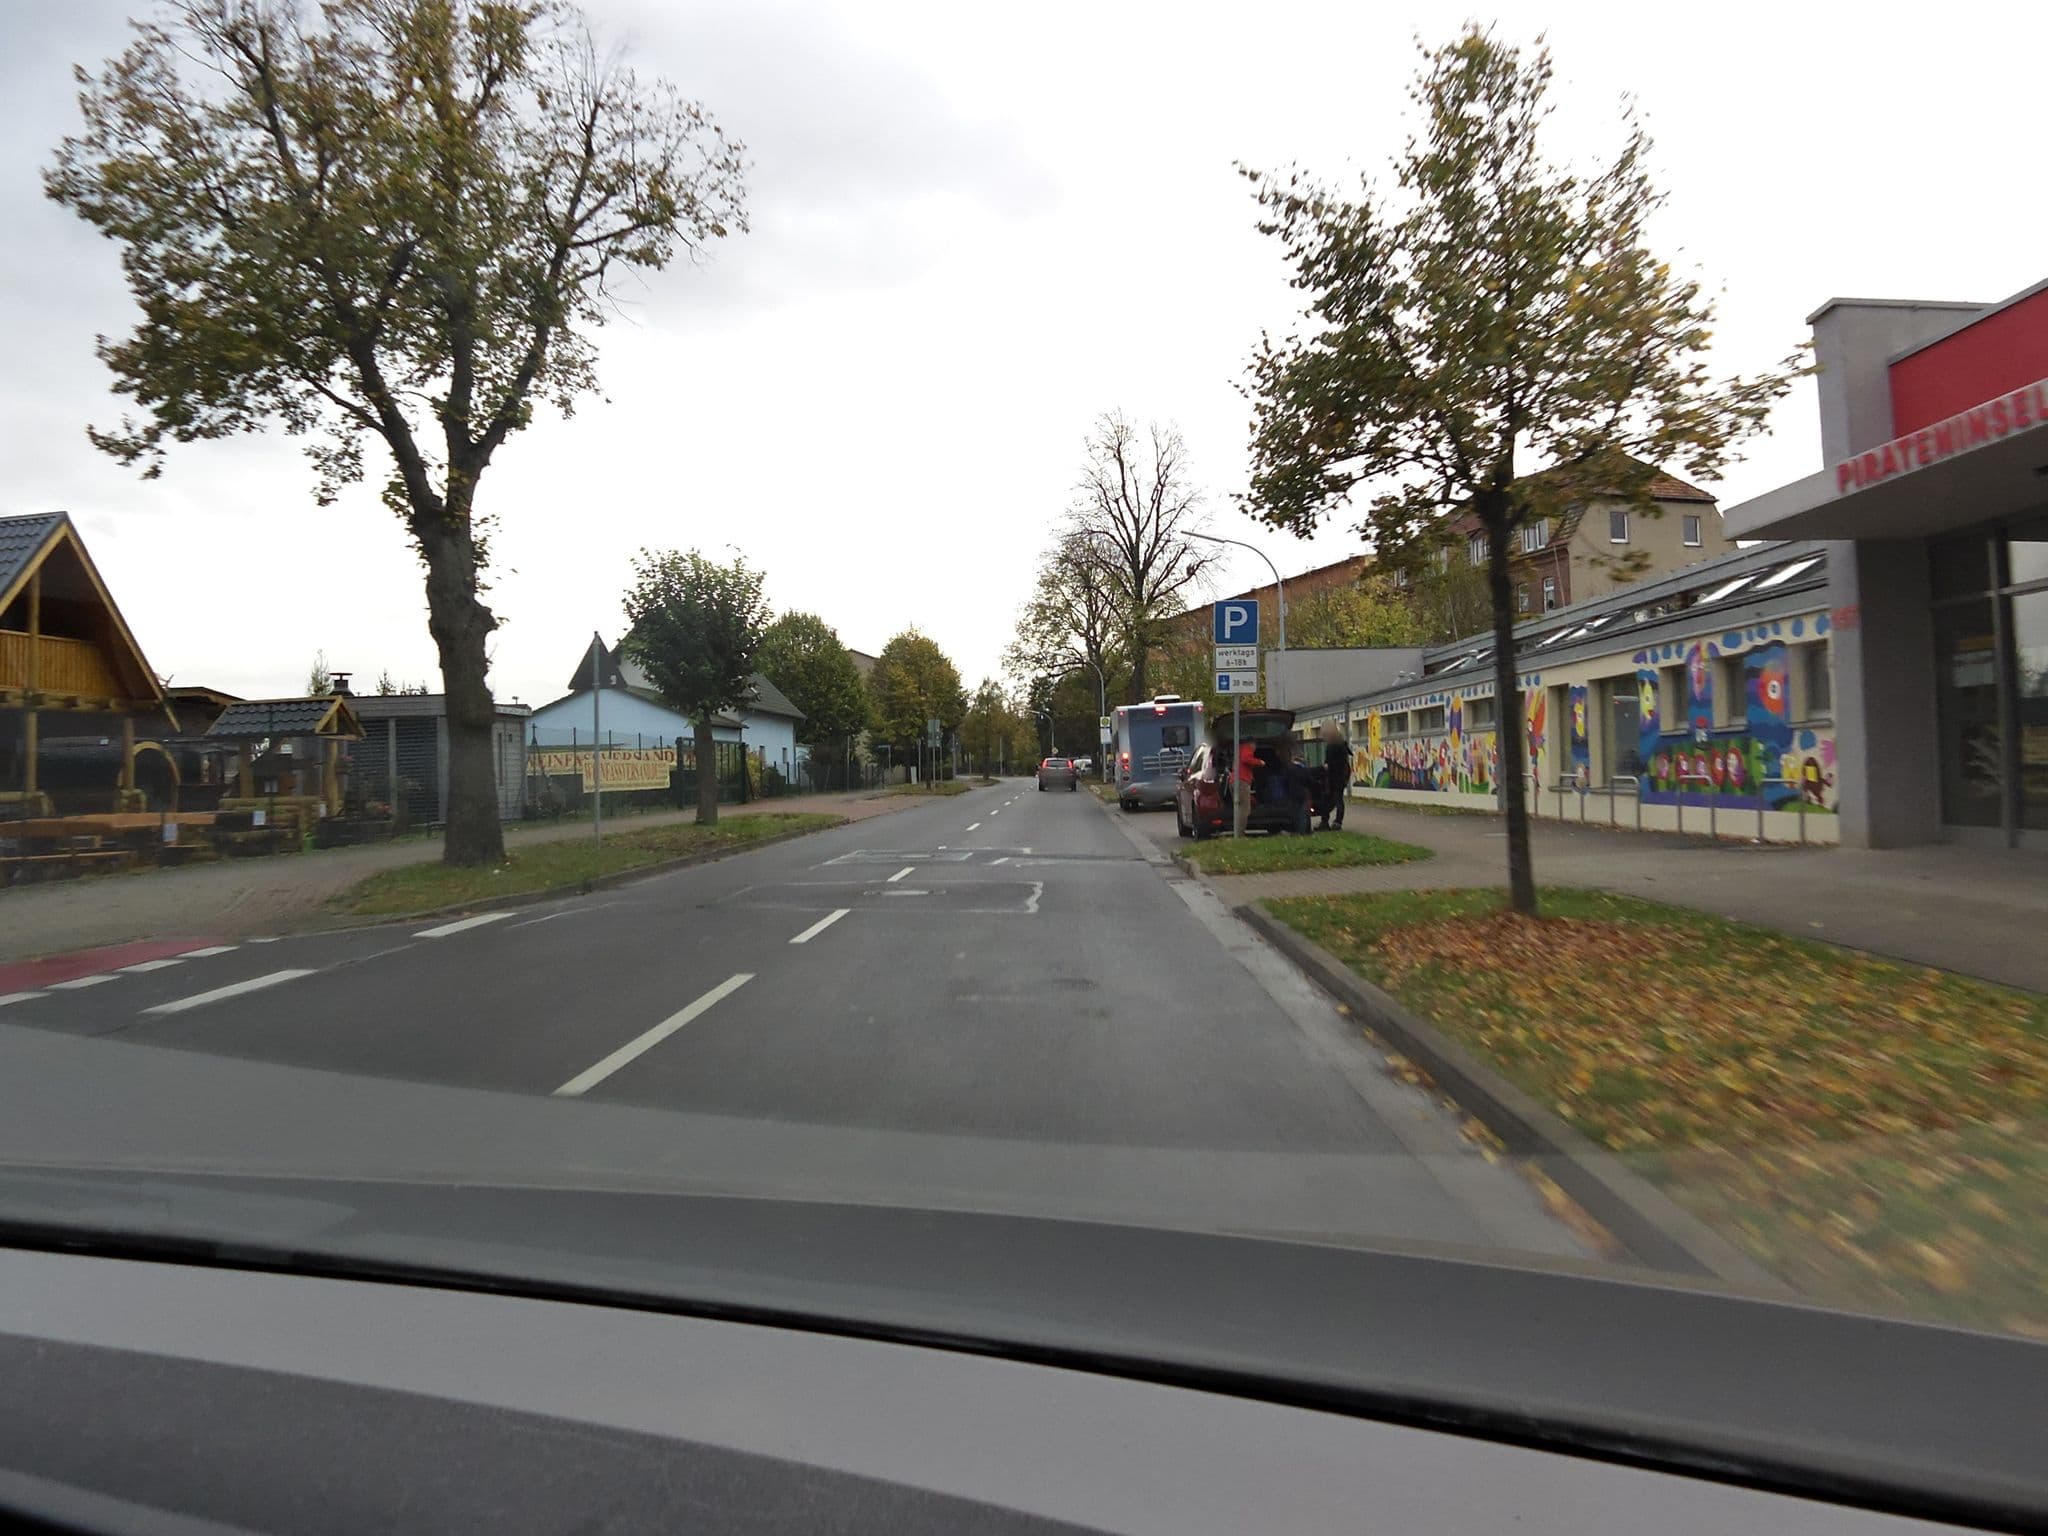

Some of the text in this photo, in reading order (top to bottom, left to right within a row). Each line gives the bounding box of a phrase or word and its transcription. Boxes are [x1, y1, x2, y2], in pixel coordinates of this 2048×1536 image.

[1836, 382, 2048, 494] PIRATENINSEL
[1224, 606, 1248, 639] P
[1217, 649, 1256, 658] werktags
